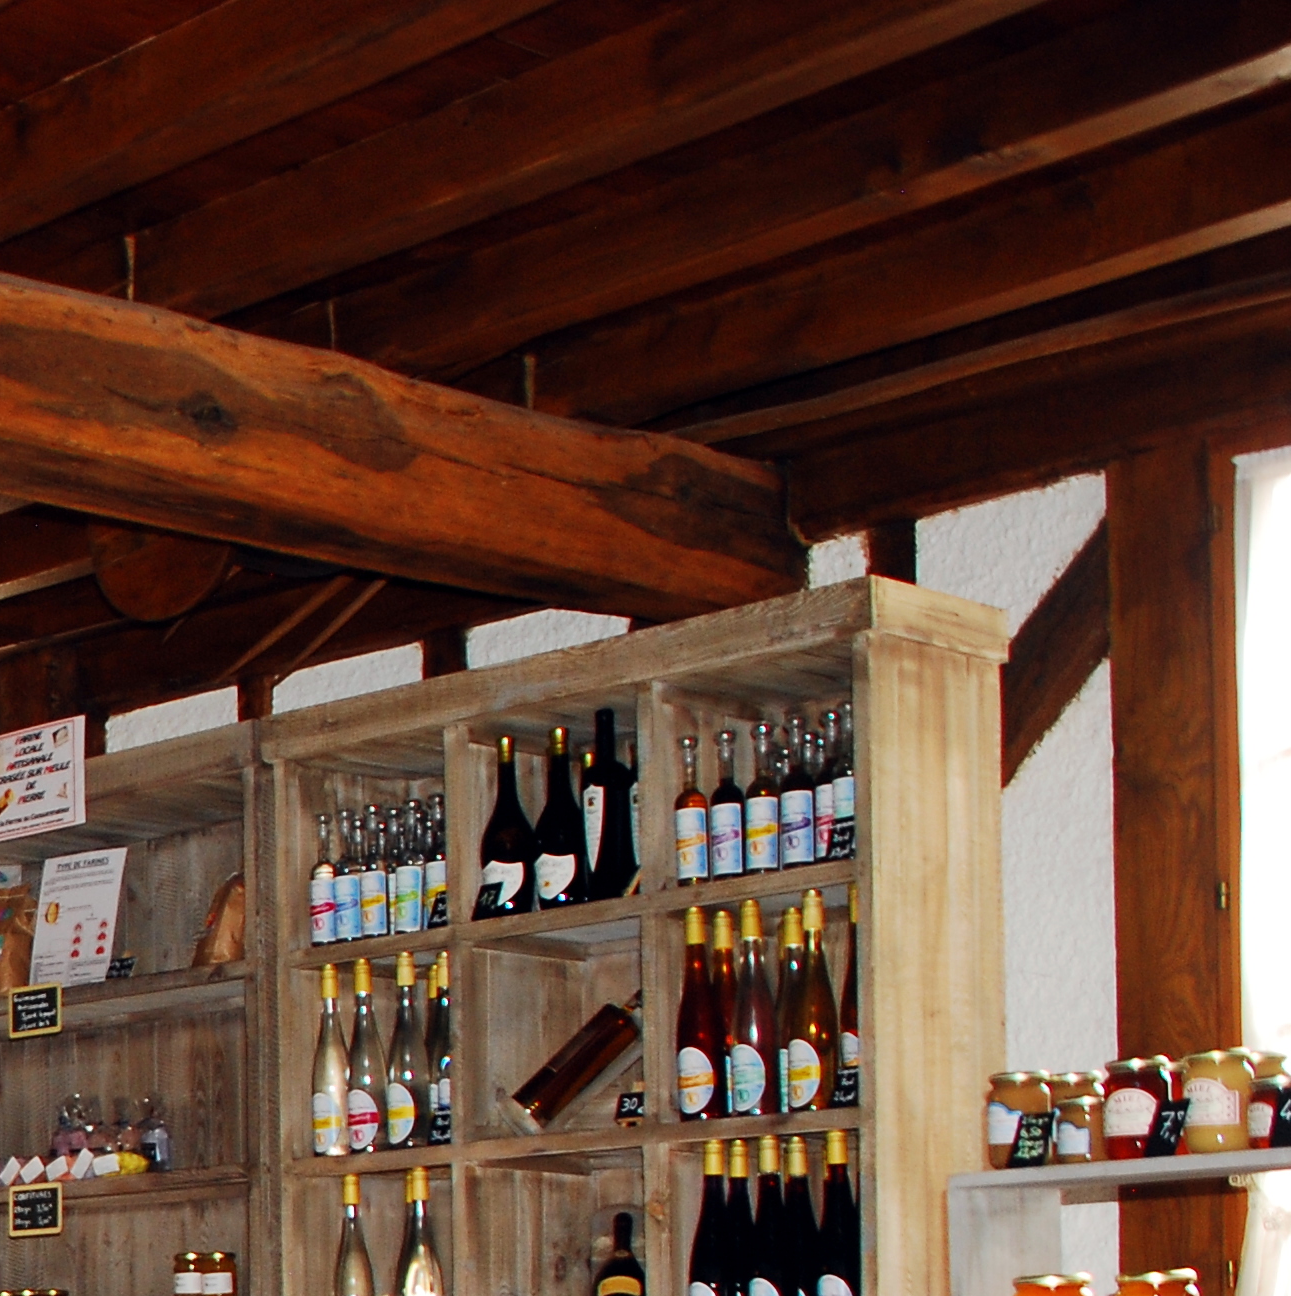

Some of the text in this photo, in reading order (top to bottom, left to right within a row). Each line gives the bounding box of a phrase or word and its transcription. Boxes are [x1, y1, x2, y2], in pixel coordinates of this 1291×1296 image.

[14, 742, 44, 757] LOCALE
[6, 752, 54, 771] ARTISANALE
[27, 767, 44, 778] SUR
[26, 781, 37, 792] DE
